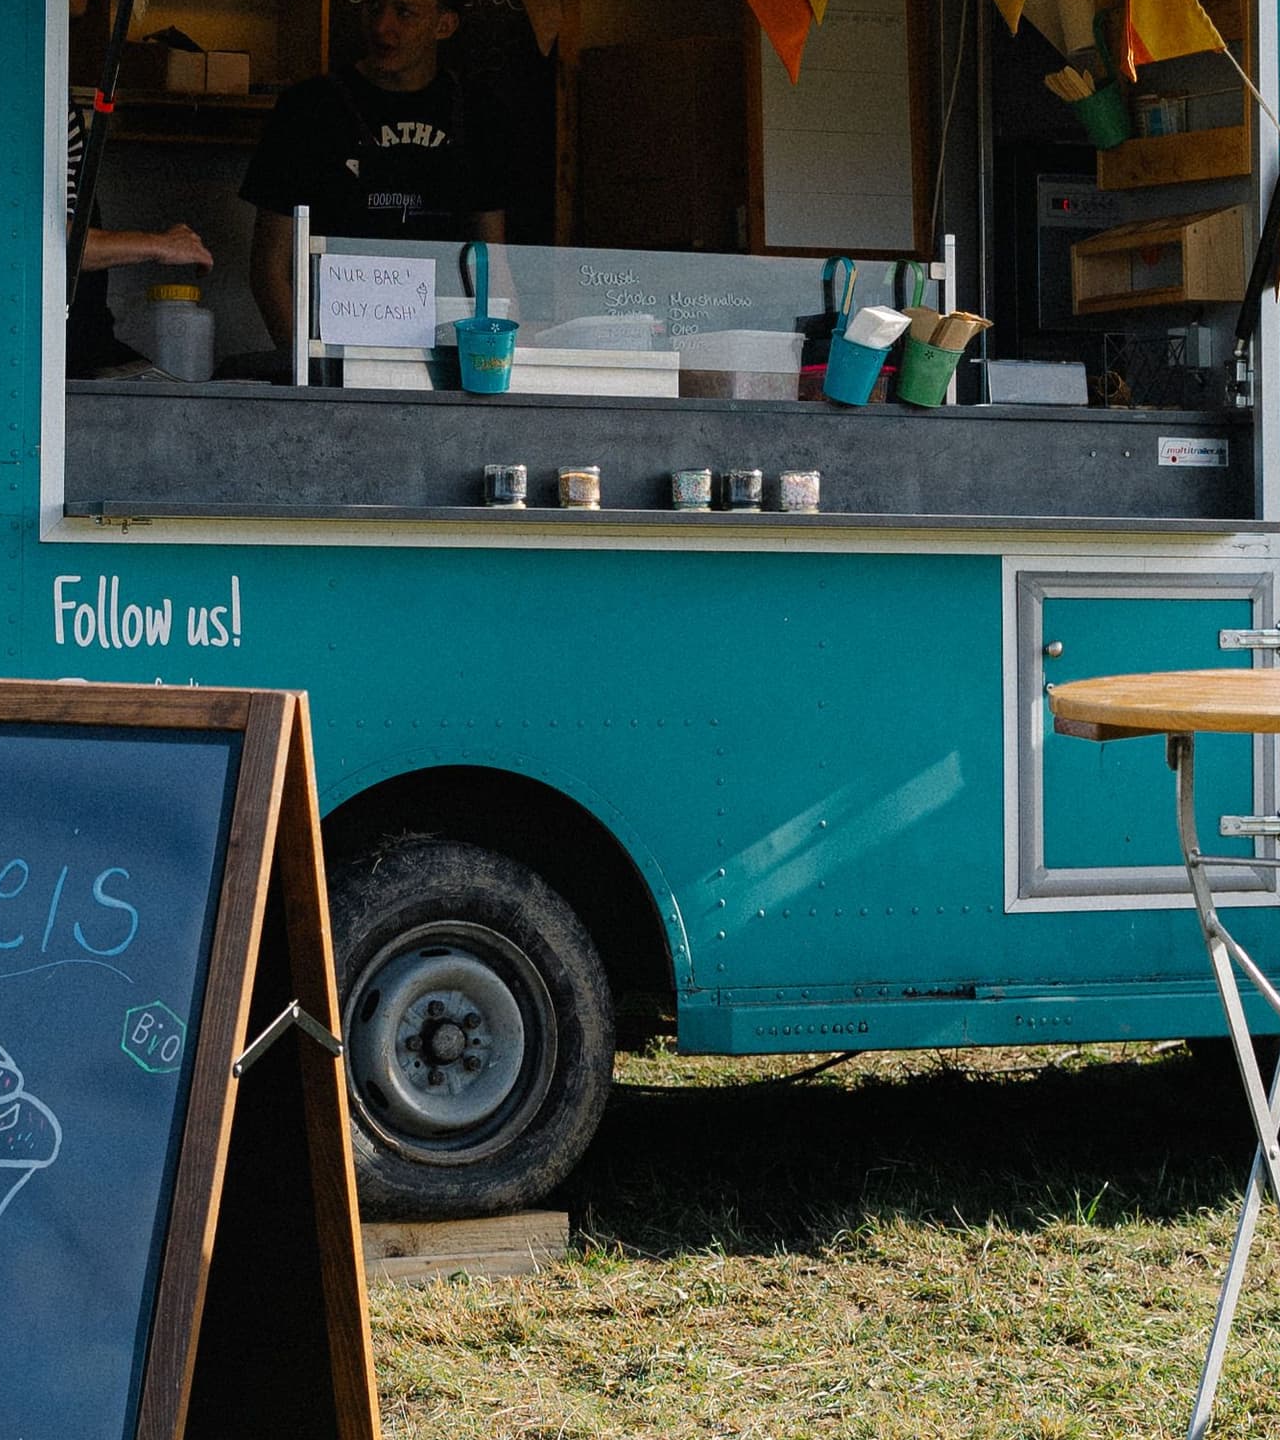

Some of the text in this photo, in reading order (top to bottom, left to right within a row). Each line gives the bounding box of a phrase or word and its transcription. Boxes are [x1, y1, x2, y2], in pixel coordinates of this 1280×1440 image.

[328, 265, 366, 283] NUR
[330, 300, 368, 318] ONLY
[53, 574, 242, 649] Follow us!
